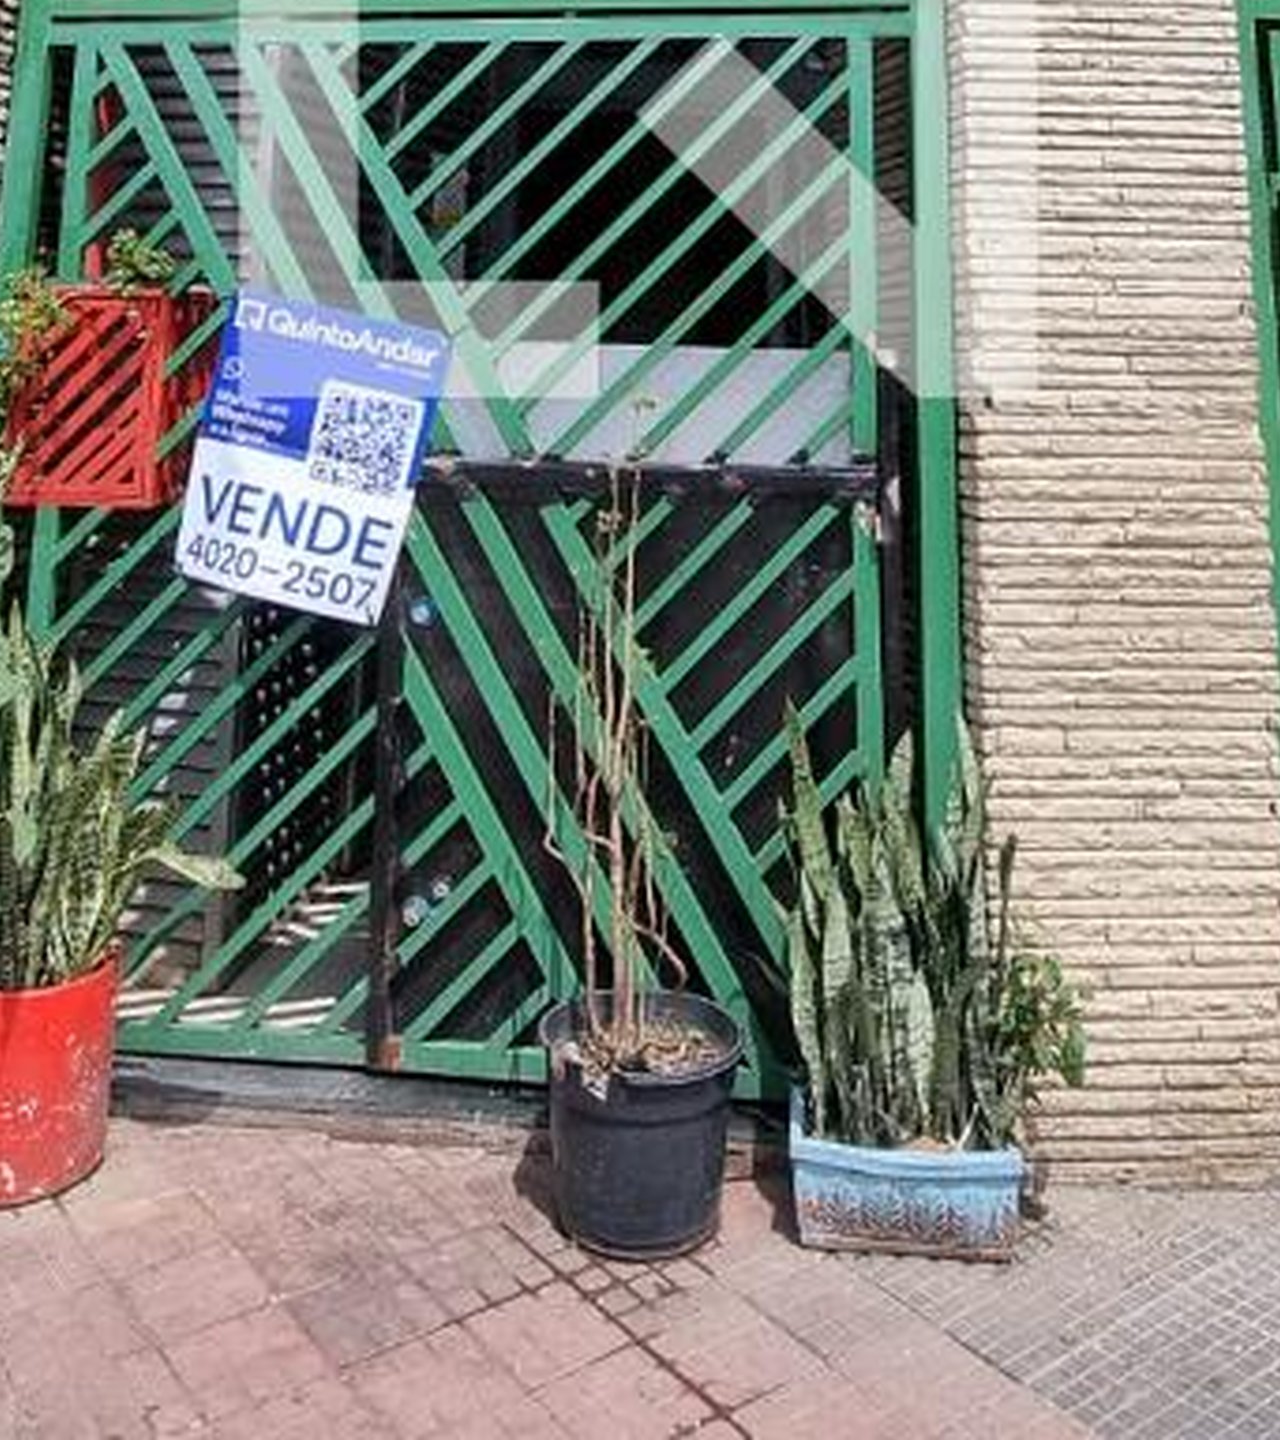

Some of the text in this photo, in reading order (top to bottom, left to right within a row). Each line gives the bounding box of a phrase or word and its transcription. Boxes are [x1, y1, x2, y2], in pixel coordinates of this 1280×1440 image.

[268, 308, 439, 368] QuintoAndar
[201, 473, 395, 571] VENDE
[186, 533, 378, 610] 4020-2507
